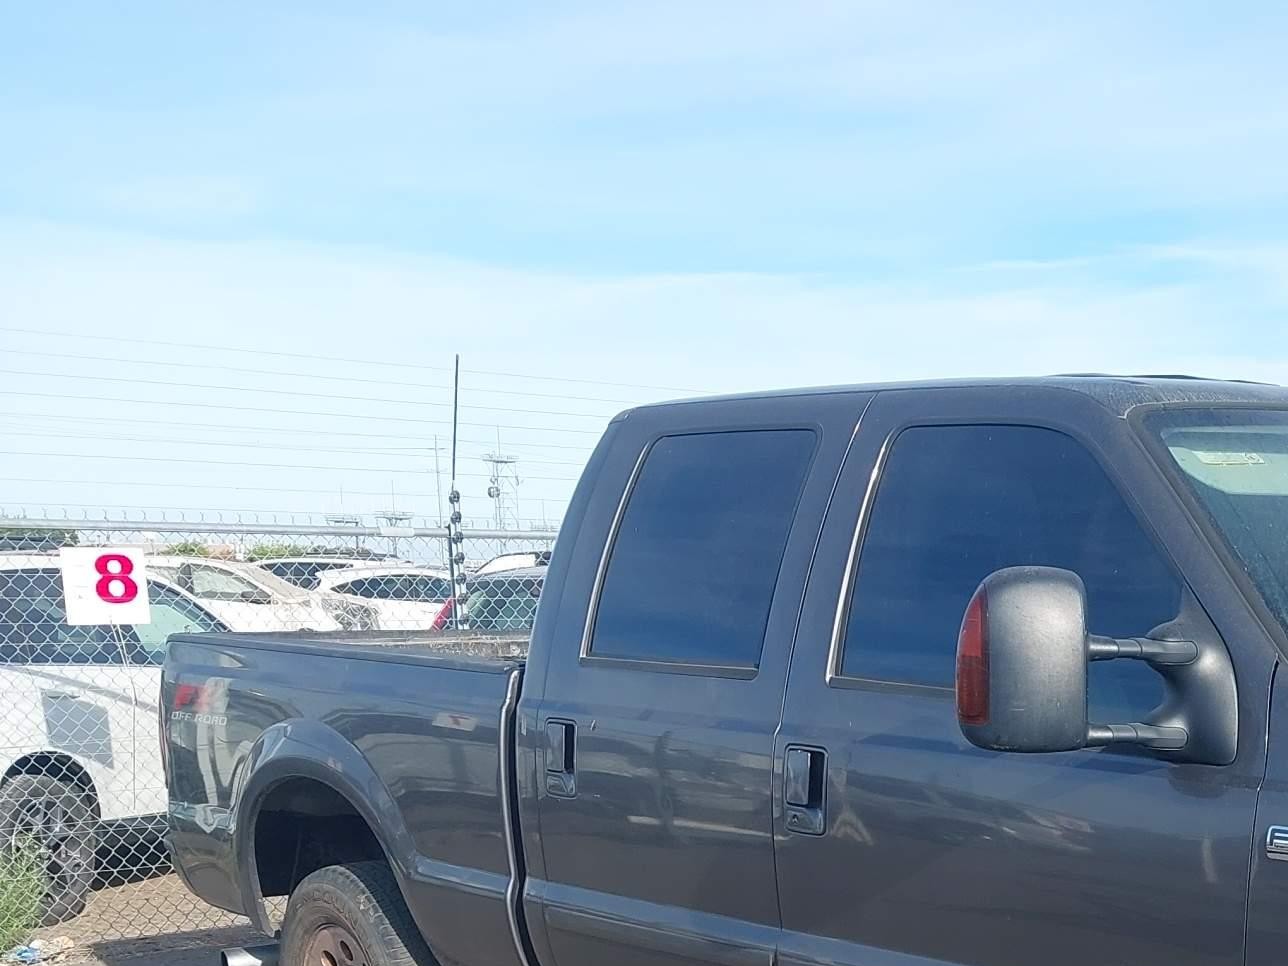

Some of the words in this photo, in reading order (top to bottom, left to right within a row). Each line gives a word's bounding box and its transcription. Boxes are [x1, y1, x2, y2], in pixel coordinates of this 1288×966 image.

[95, 554, 138, 604] 8
[171, 711, 192, 721] OFF
[194, 714, 227, 726] ROAD
